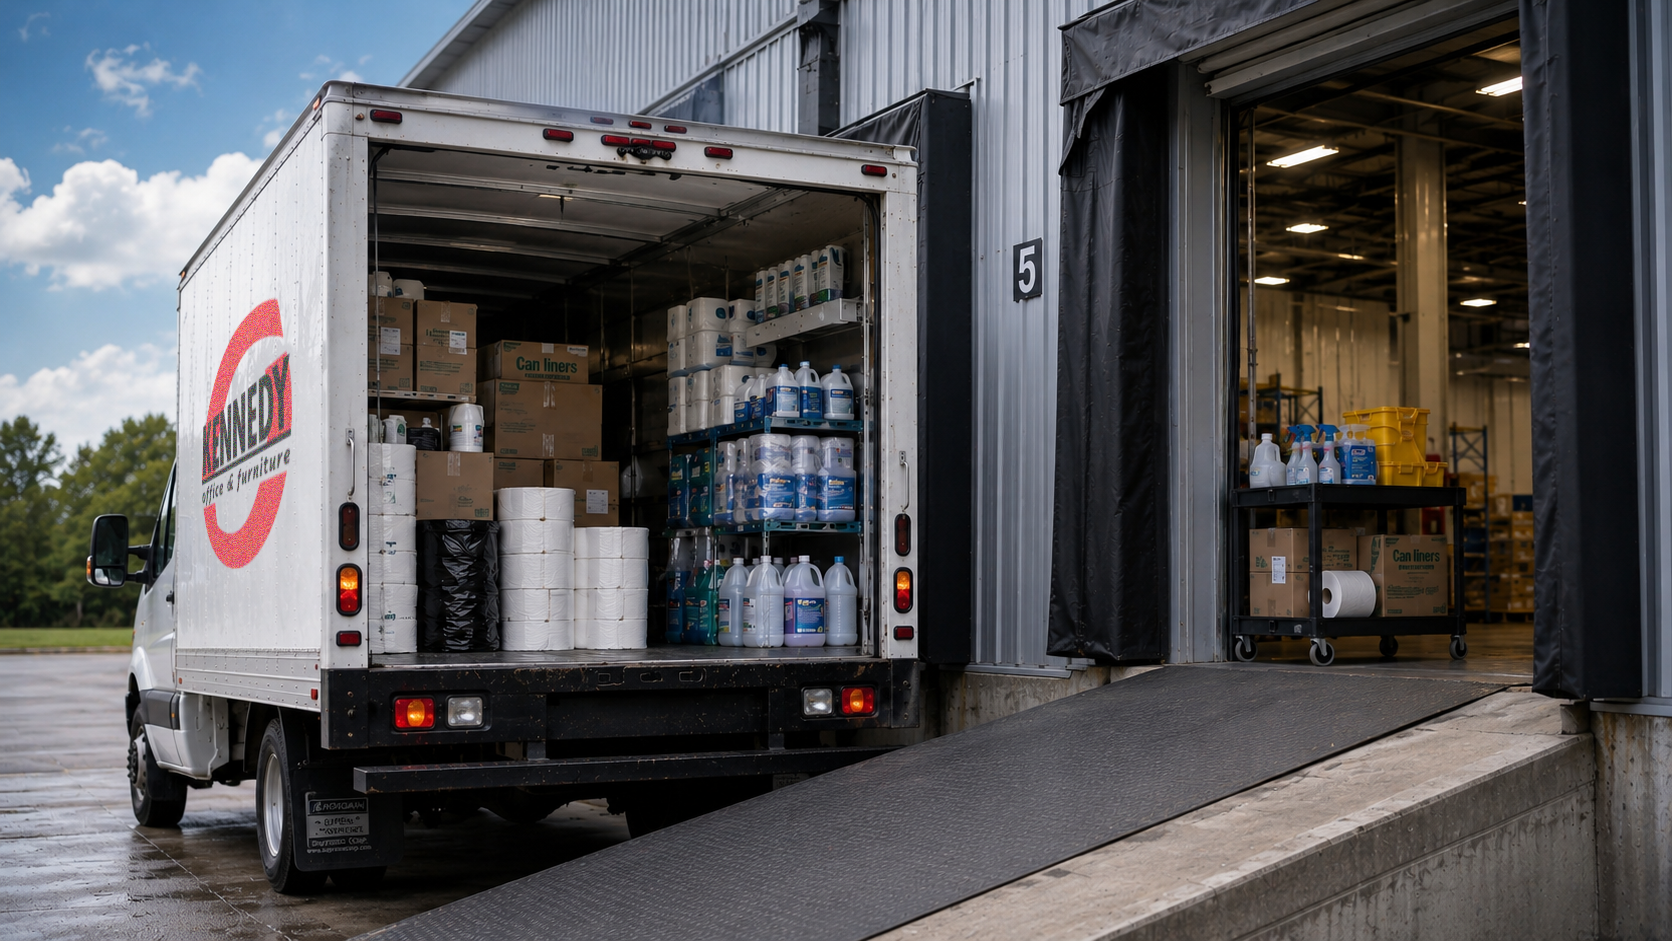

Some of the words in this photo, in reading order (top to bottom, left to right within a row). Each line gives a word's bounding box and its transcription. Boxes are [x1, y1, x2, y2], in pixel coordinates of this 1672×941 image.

[1018, 245, 1036, 293] 5
[516, 356, 540, 371] Can
[543, 358, 577, 373] liners
[202, 354, 290, 476] KENNEDY
[202, 482, 224, 506] office
[227, 473, 234, 491] &
[237, 448, 290, 492] furniture
[1393, 549, 1411, 562] Can
[1413, 549, 1440, 562] liners
